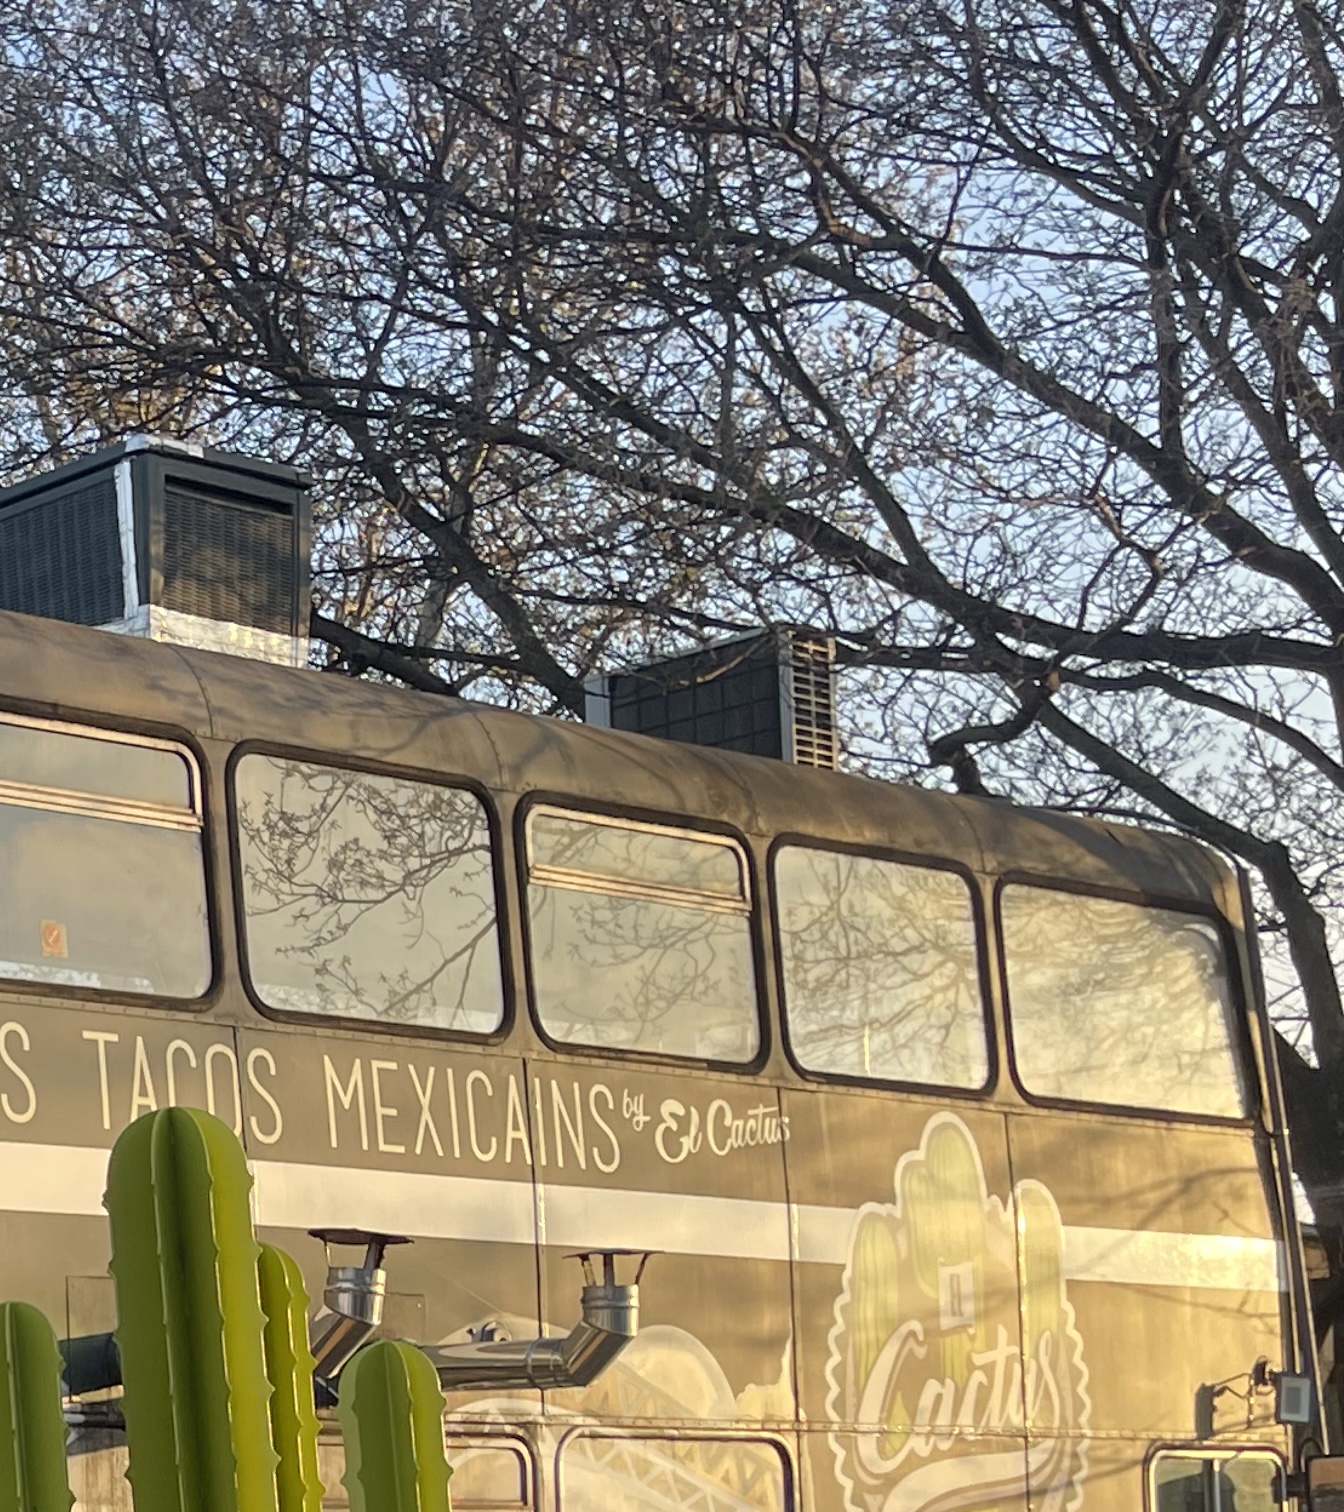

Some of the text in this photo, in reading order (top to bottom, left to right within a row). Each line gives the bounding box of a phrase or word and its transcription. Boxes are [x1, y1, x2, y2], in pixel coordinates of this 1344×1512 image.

[81, 1029, 283, 1145] TACOS
[322, 1054, 622, 1174] MEXICAINS
[621, 1087, 791, 1164] by El Cactus
[856, 1318, 1061, 1475] Cactus
